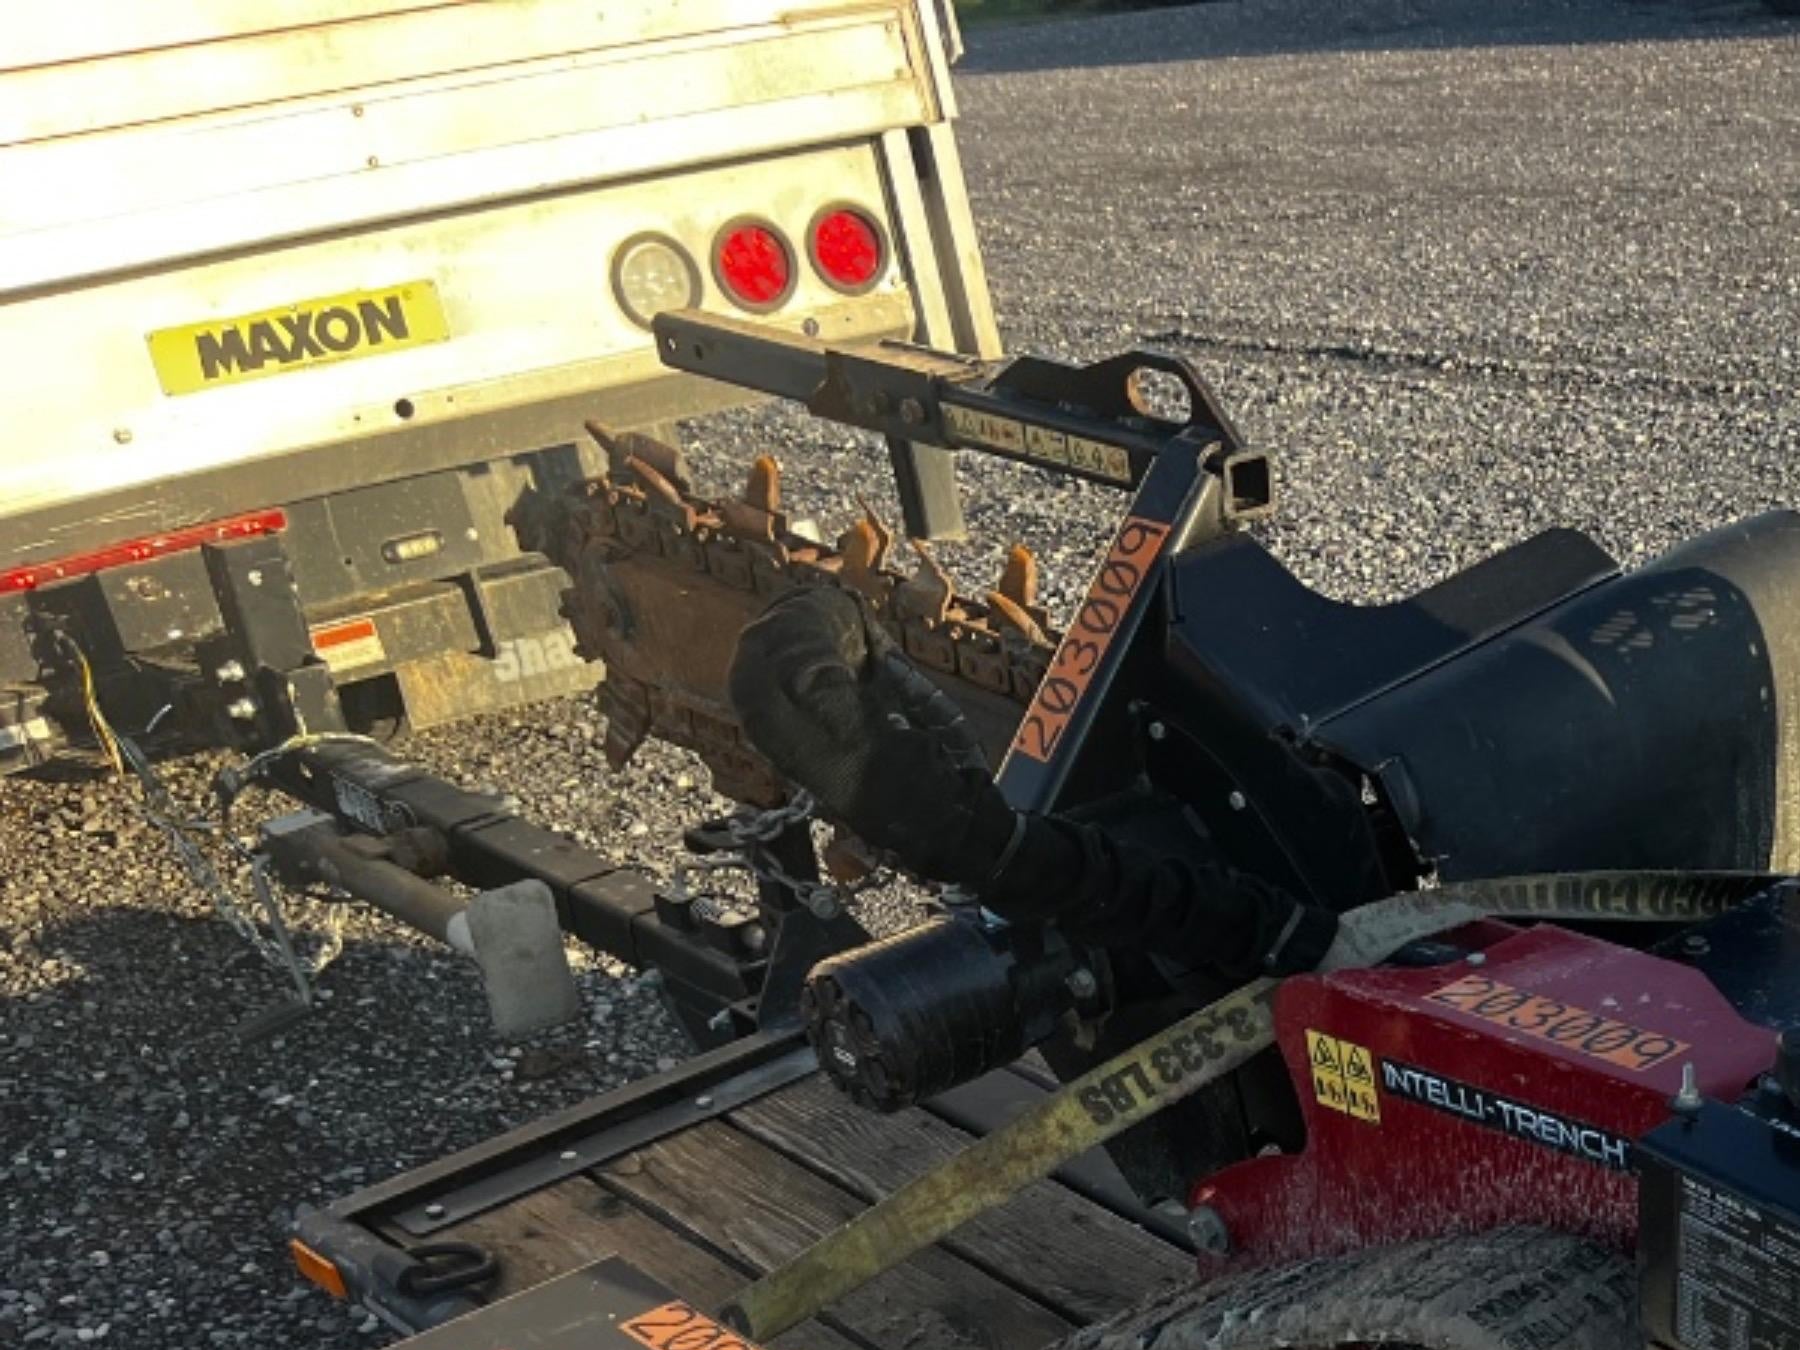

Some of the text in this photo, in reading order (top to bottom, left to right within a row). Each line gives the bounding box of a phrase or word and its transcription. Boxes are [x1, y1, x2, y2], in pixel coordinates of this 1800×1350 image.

[195, 296, 410, 380] MAXON
[1019, 520, 1164, 758] 203009
[1431, 979, 1678, 1070] 203009
[1078, 1062, 1158, 1126] LBS
[1381, 1060, 1627, 1166] INTELLI-TRENCH
